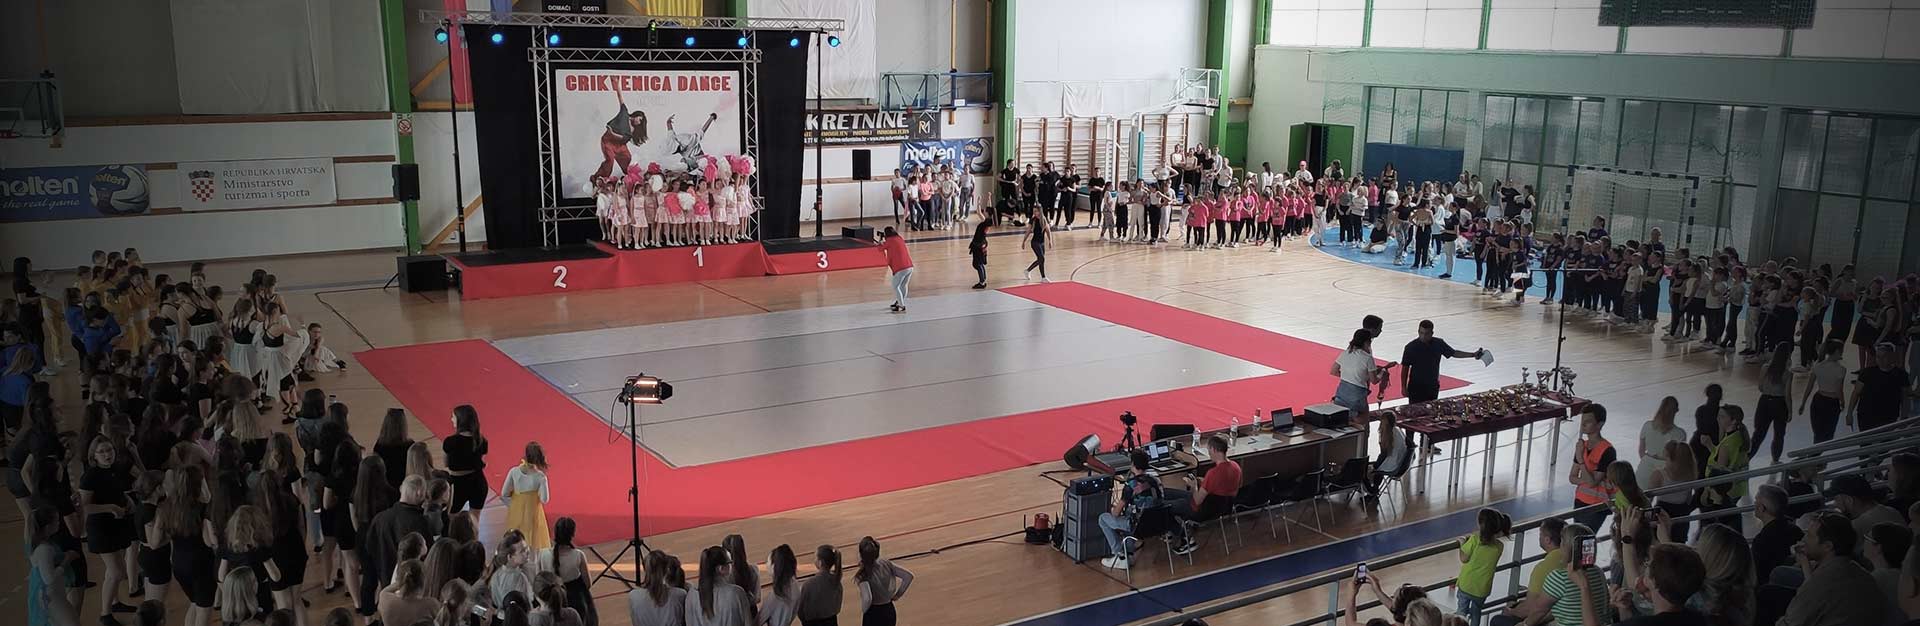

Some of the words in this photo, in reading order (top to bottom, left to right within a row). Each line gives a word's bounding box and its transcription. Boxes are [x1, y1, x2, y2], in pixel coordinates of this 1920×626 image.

[565, 74, 672, 92] CRIKVENICA
[677, 75, 731, 92] DANCE
[804, 111, 909, 131] KRETNINE
[905, 146, 956, 161] molten
[223, 168, 275, 177] REPUBLIKA
[277, 167, 327, 176] HRVATSKA
[224, 179, 294, 189] Ministarstvo
[224, 190, 267, 200] turizma
[277, 189, 310, 200] sporta
[693, 246, 704, 267] 1
[816, 251, 829, 269] 3
[553, 265, 567, 289] 2
